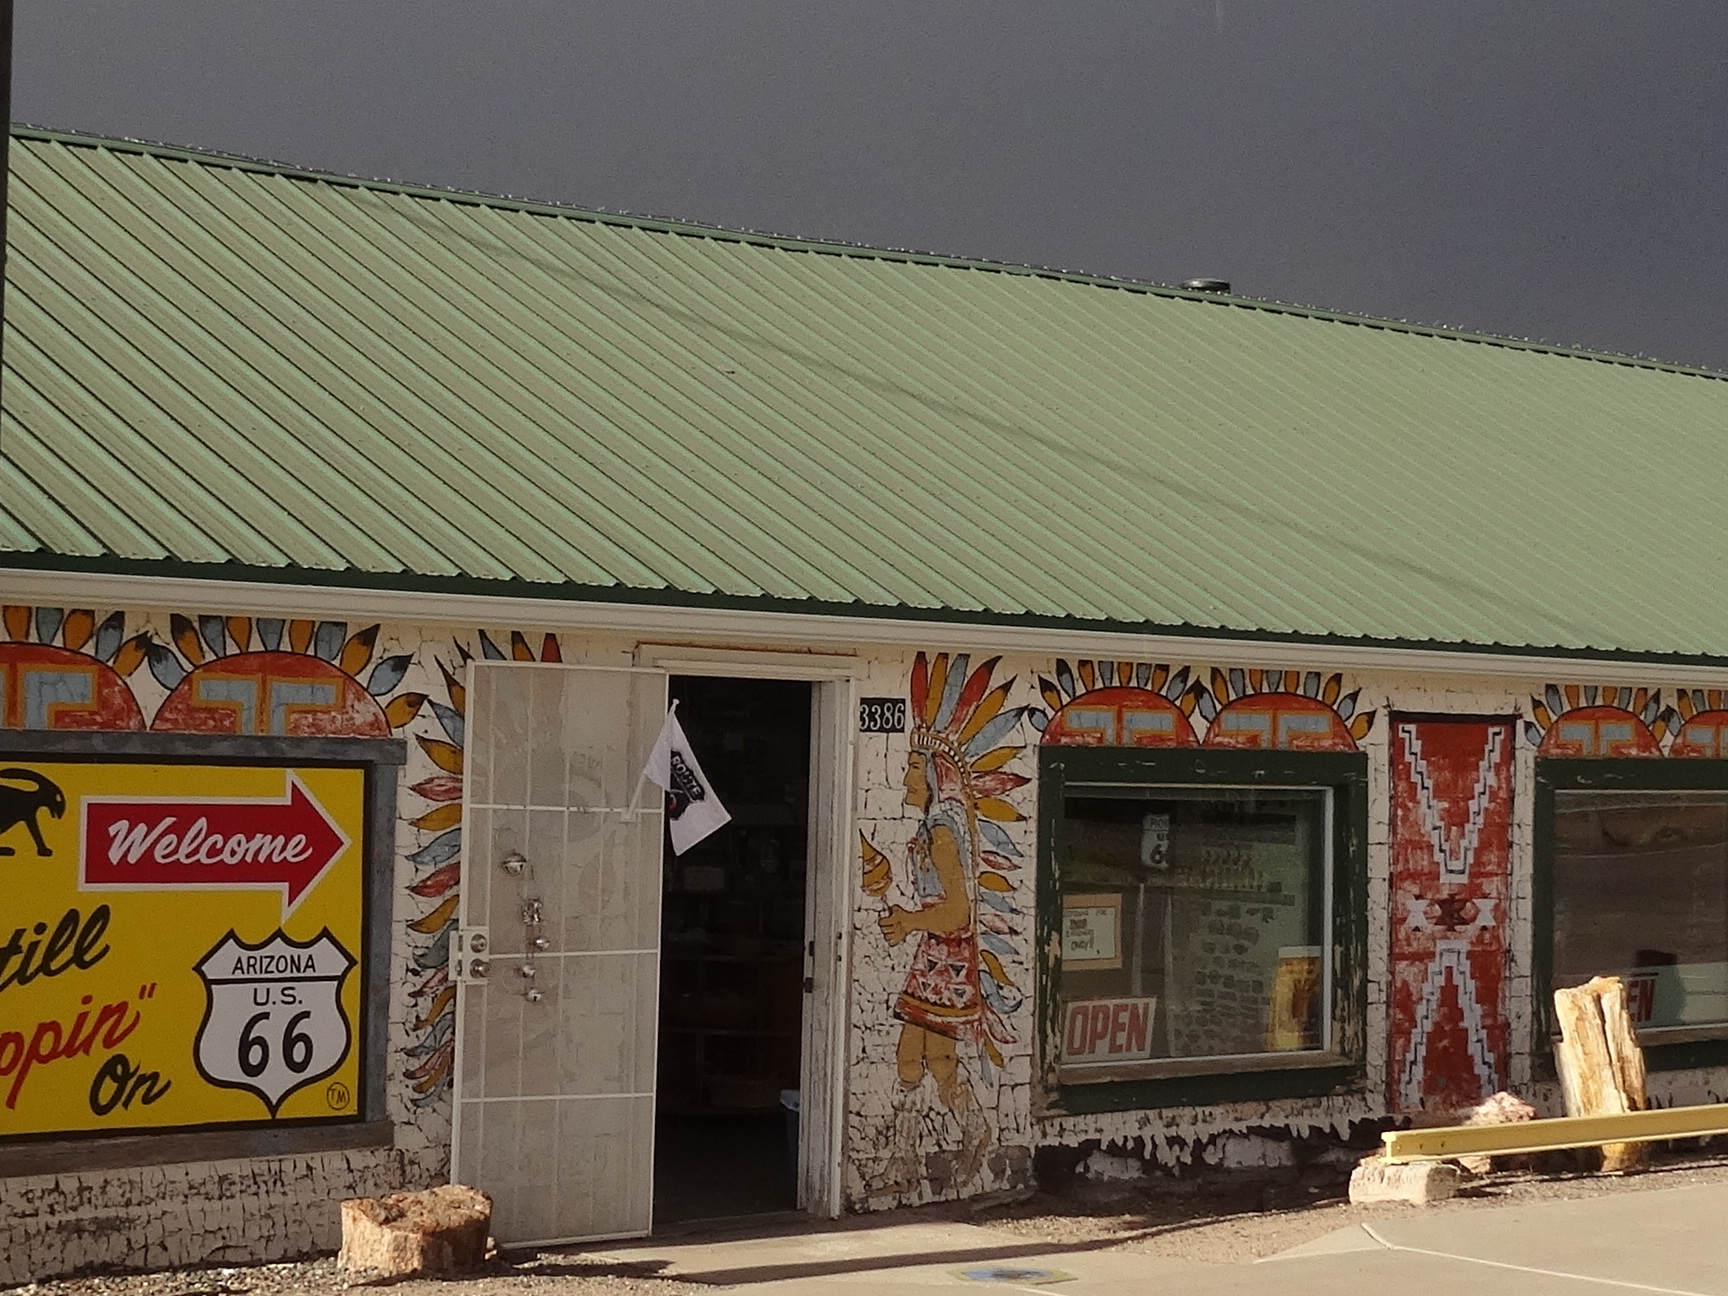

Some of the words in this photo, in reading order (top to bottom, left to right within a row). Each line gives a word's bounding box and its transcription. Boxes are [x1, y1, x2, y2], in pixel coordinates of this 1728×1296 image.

[859, 703, 905, 730] 3386
[672, 755, 702, 798] ROUTE
[107, 816, 313, 866] Welcome
[231, 953, 317, 976] ARIZONA
[252, 985, 303, 1007] U.S.
[237, 1010, 314, 1078] 66
[1066, 1002, 1150, 1056] OPEN
[88, 1053, 172, 1117] On
